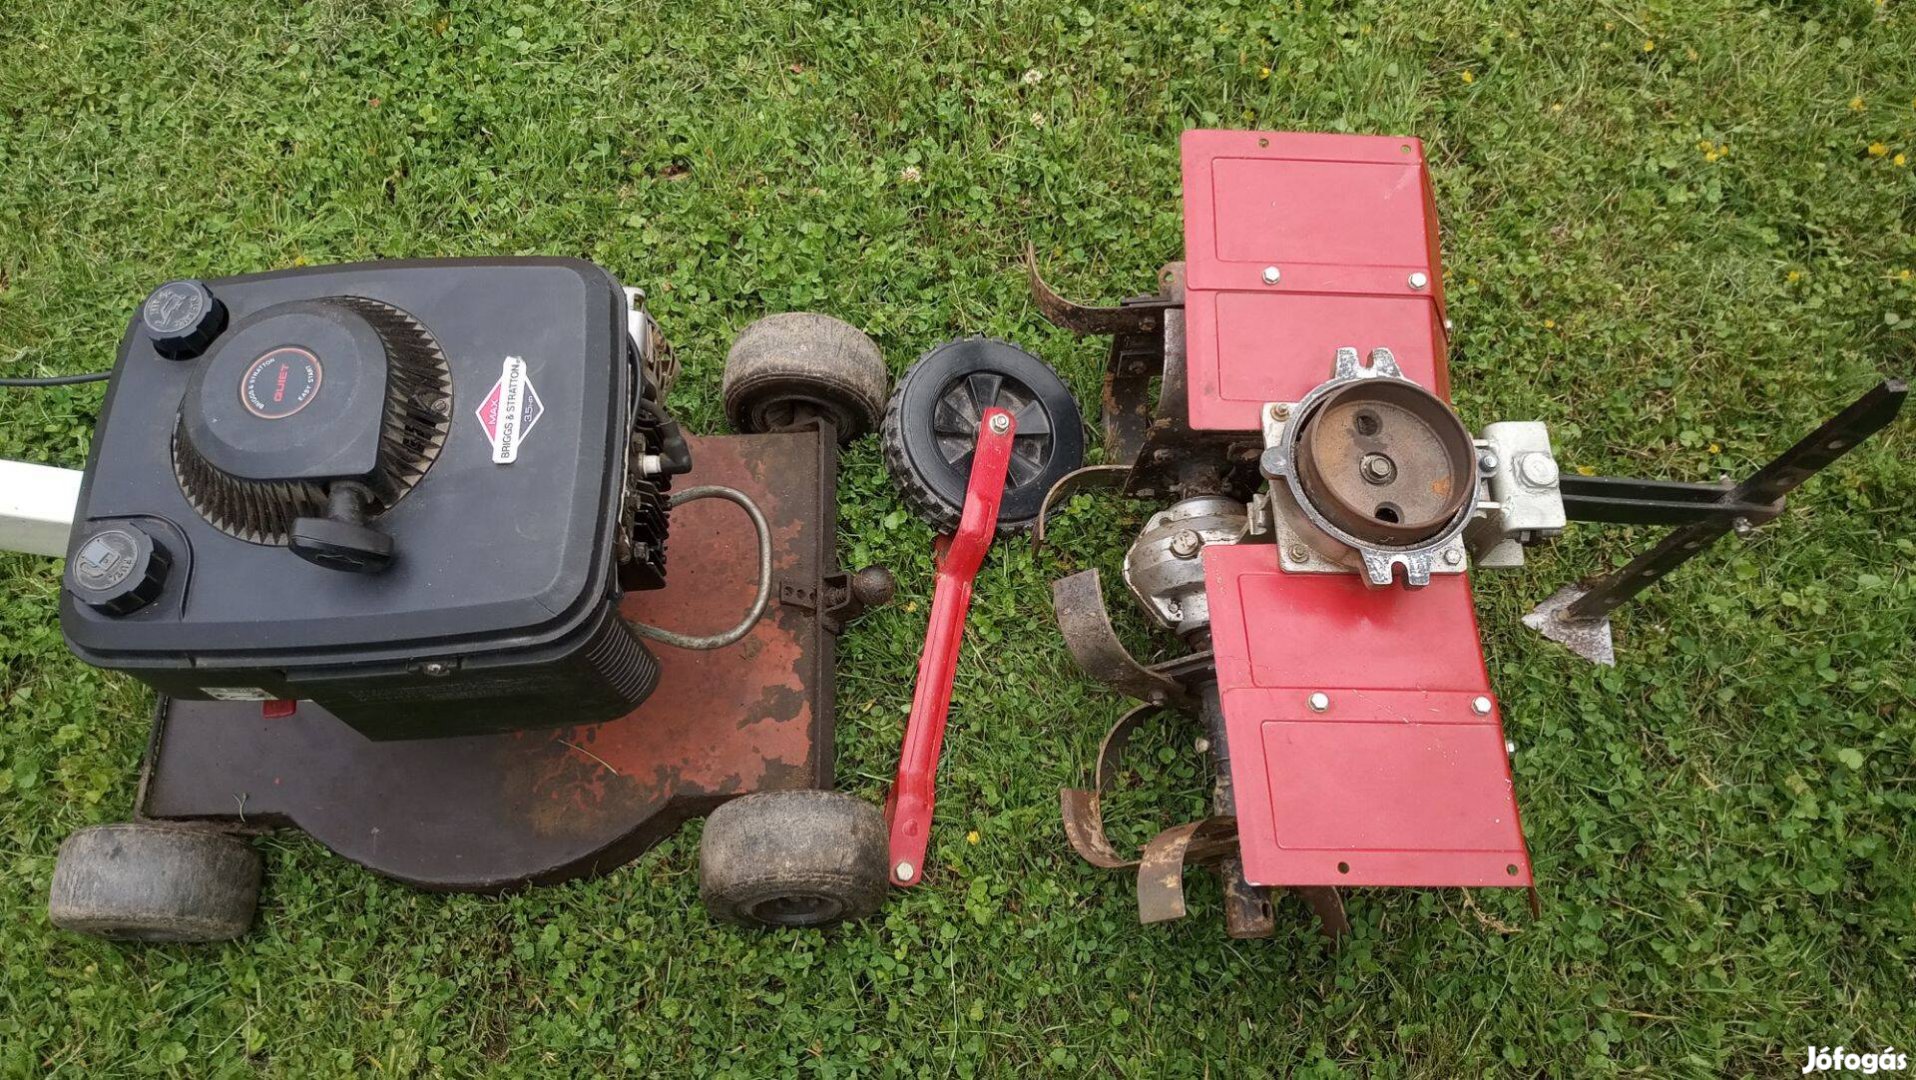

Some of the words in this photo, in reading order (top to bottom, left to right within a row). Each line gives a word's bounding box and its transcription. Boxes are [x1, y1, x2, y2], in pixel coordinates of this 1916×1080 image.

[273, 363, 290, 402] QUIET
[298, 386, 311, 401] EASY
[488, 399, 499, 425] MAX
[501, 423, 513, 458] BRIGGS
[507, 364, 520, 412] STRATTON
